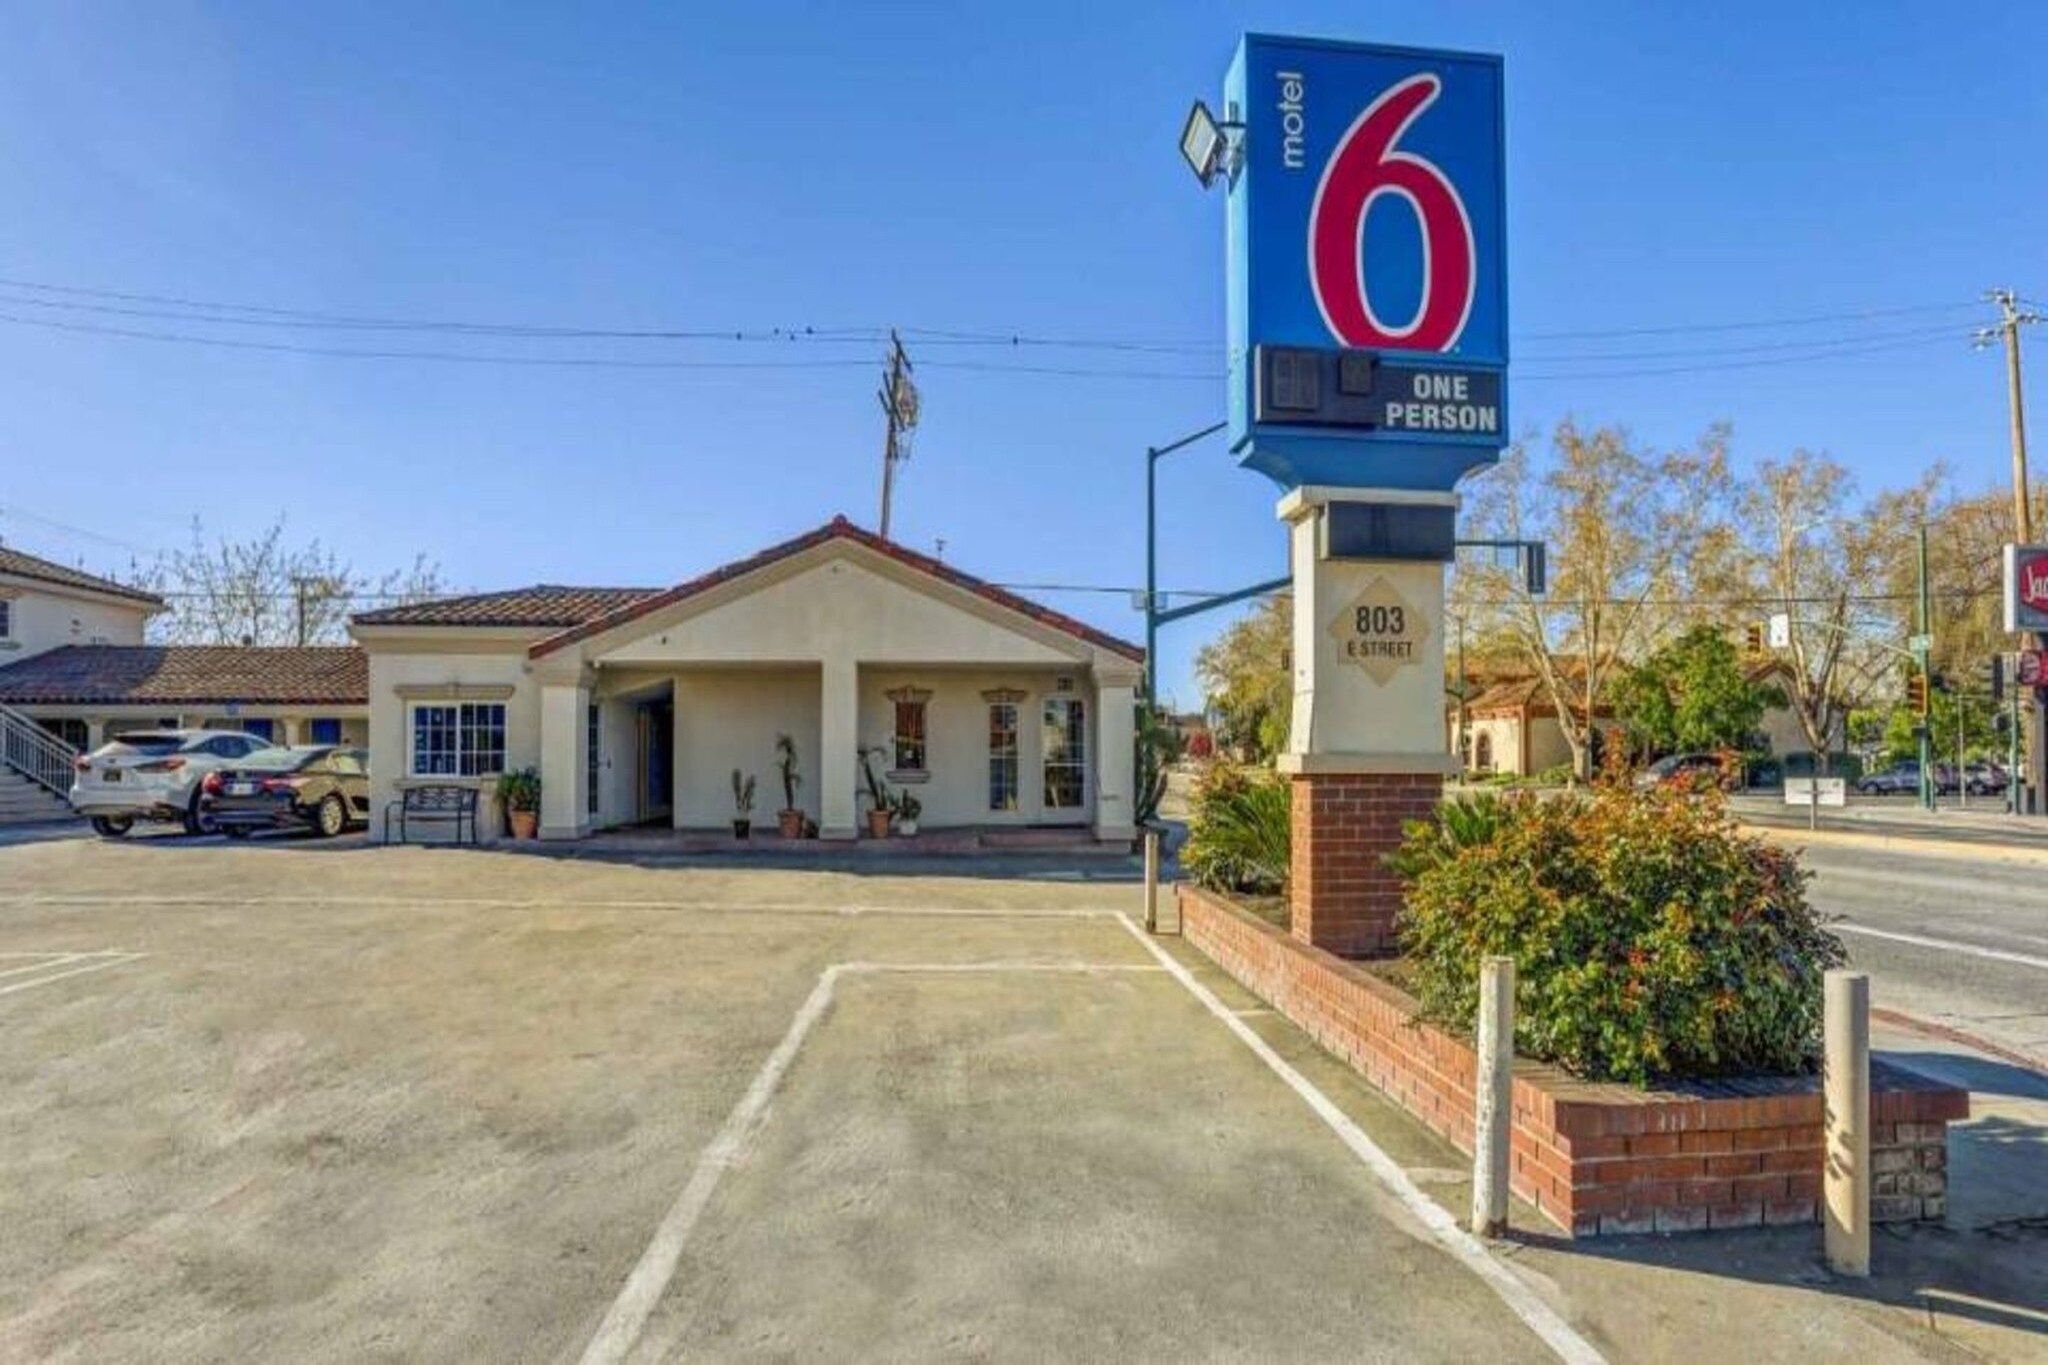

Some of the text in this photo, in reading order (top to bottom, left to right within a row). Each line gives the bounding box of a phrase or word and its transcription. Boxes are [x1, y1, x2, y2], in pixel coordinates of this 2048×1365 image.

[1276, 71, 1305, 168] motel
[1307, 72, 1477, 353] 6
[1413, 373, 1469, 400] ONE
[1385, 402, 1498, 431] PERSON
[1356, 605, 1405, 634] 803
[1347, 640, 1412, 657] E STREET
